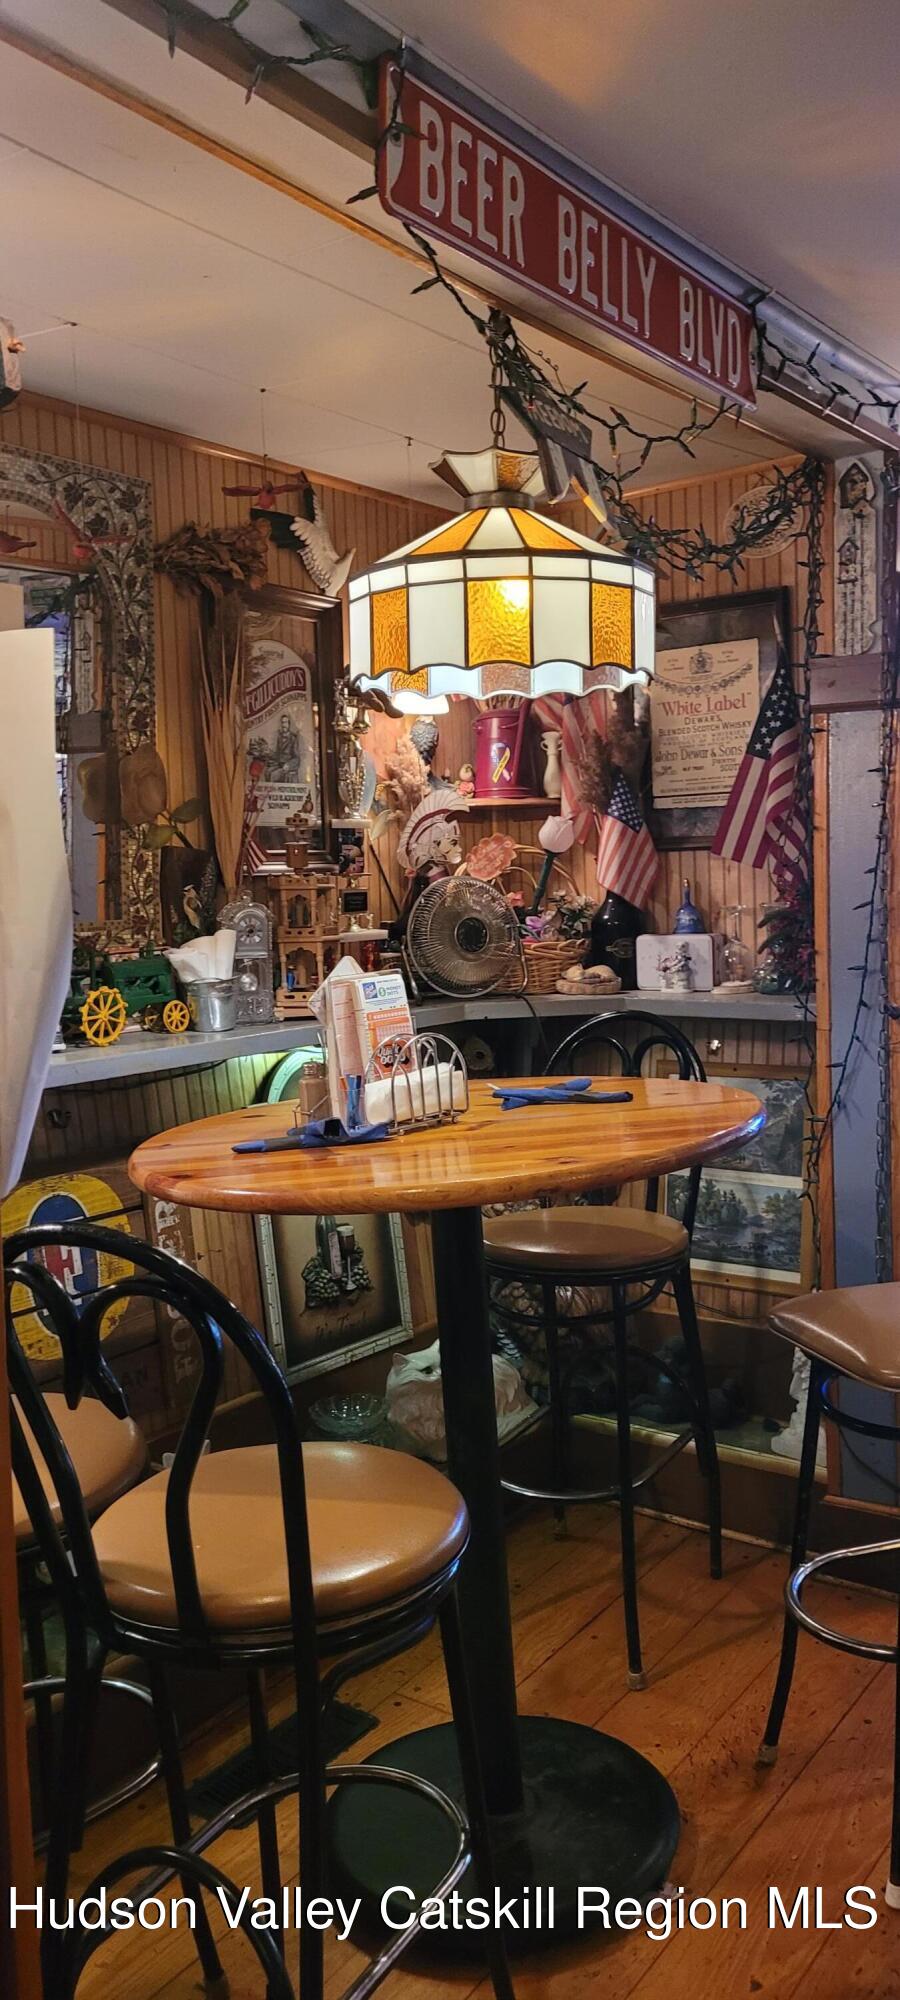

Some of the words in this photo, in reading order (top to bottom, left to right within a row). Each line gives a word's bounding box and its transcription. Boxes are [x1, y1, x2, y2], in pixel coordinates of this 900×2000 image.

[419, 100, 526, 269] BEER
[558, 194, 657, 339] BELLY
[679, 275, 742, 388] BLVD
[658, 727, 691, 737] BLENDED
[692, 724, 720, 734] SCOTCH
[721, 720, 752, 730] WHISKY
[655, 750, 678, 762] John
[680, 748, 708, 761] Dewar
[710, 748, 717, 758] &
[719, 744, 743, 756] Sons
